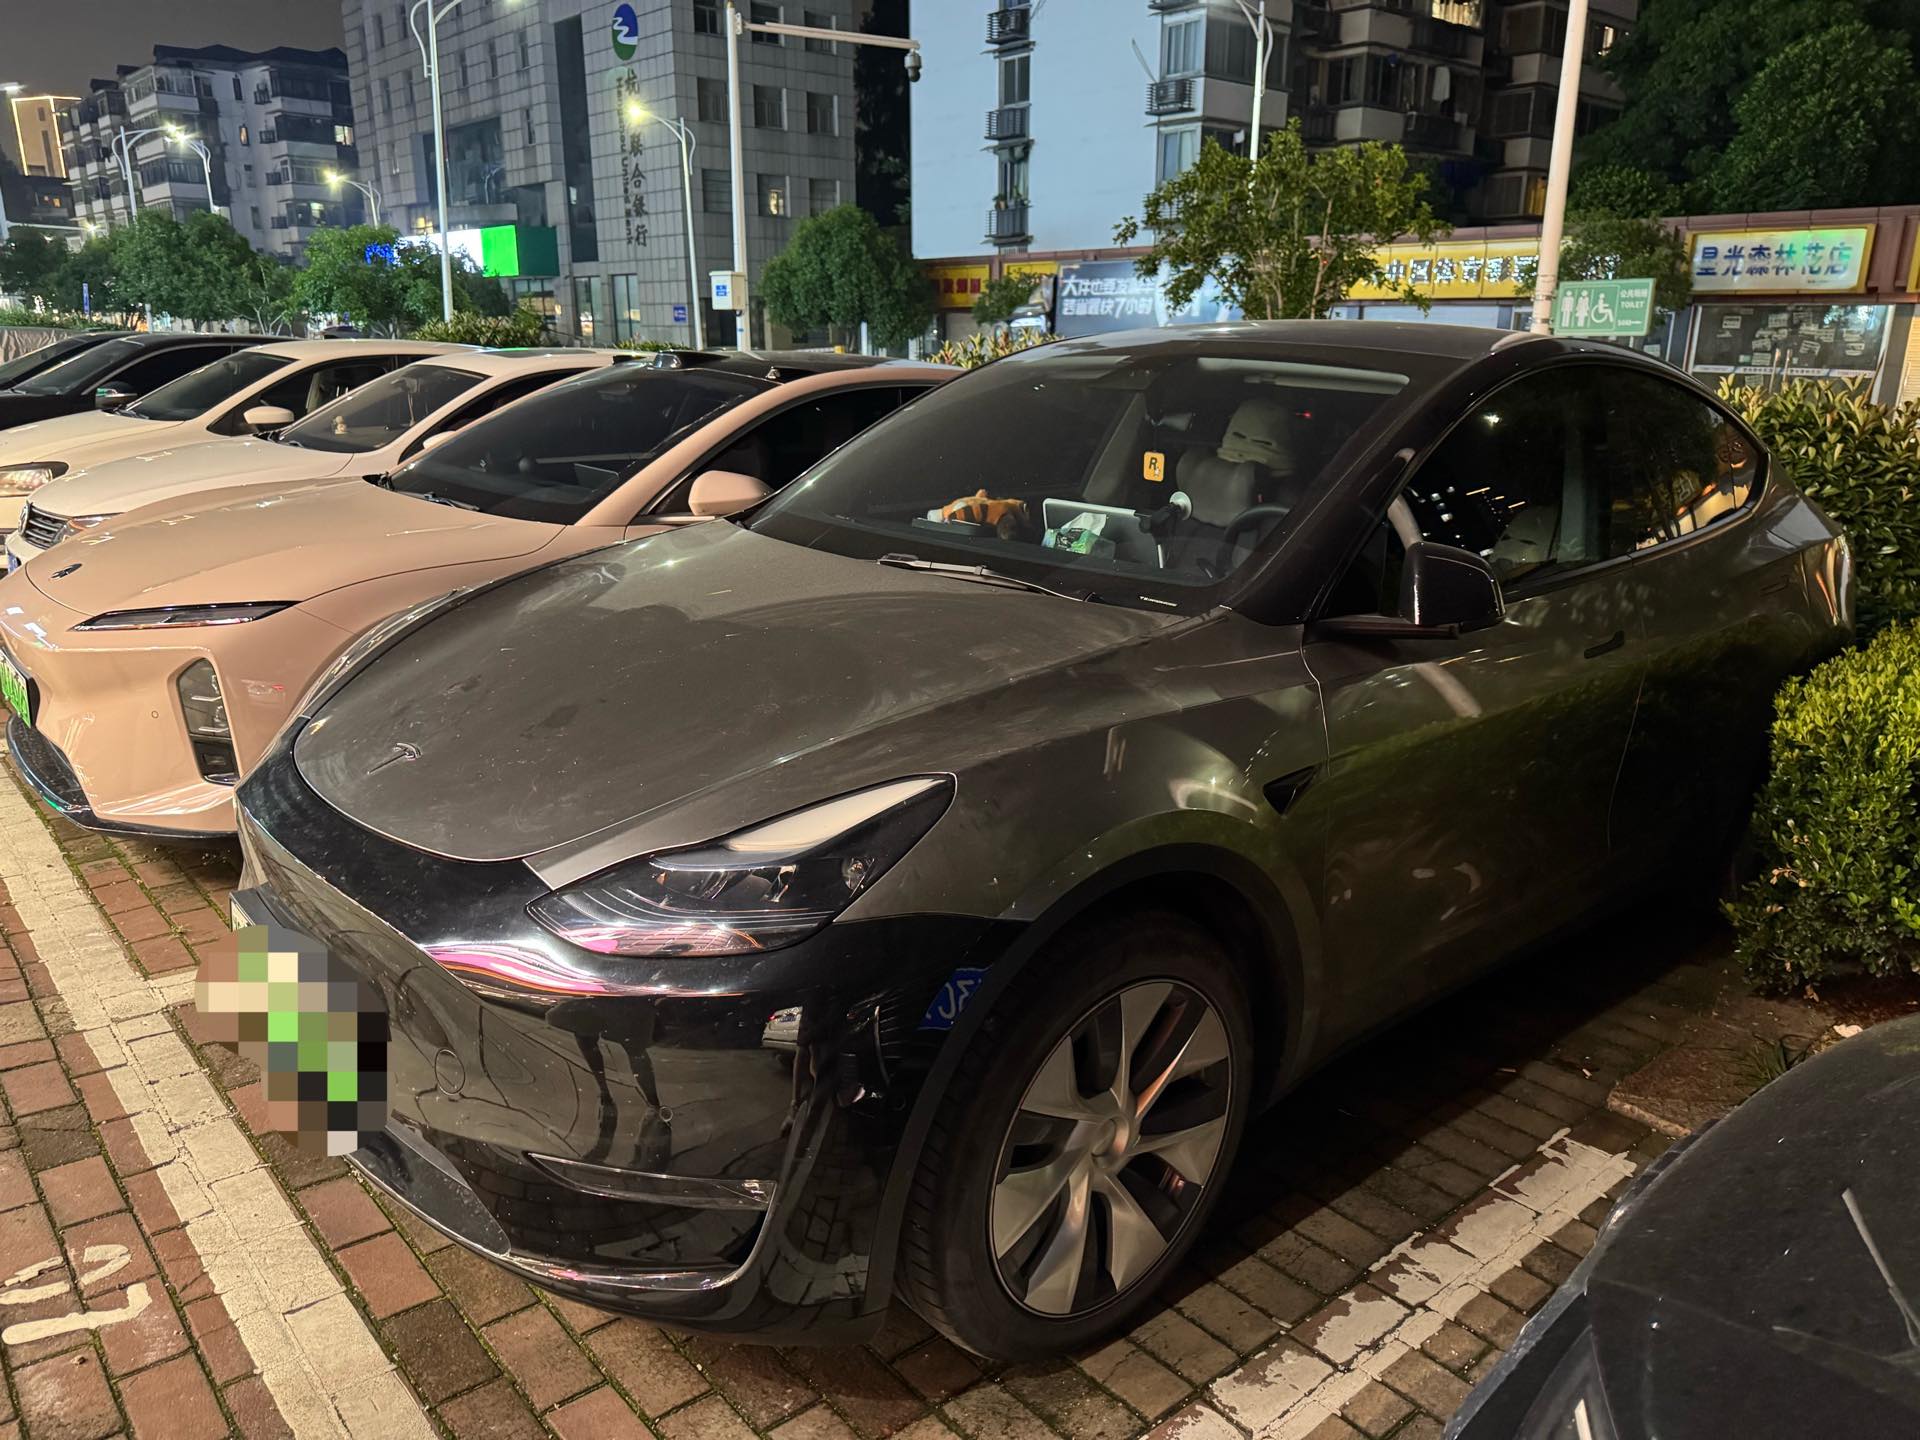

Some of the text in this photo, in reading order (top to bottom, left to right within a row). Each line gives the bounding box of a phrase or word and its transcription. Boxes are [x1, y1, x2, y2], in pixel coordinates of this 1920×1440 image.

[624, 67, 649, 247] 杭联合银行
[1696, 243, 1853, 277] 星光森林花店
[1621, 300, 1645, 310] TOILET
[1149, 457, 1158, 470] R
